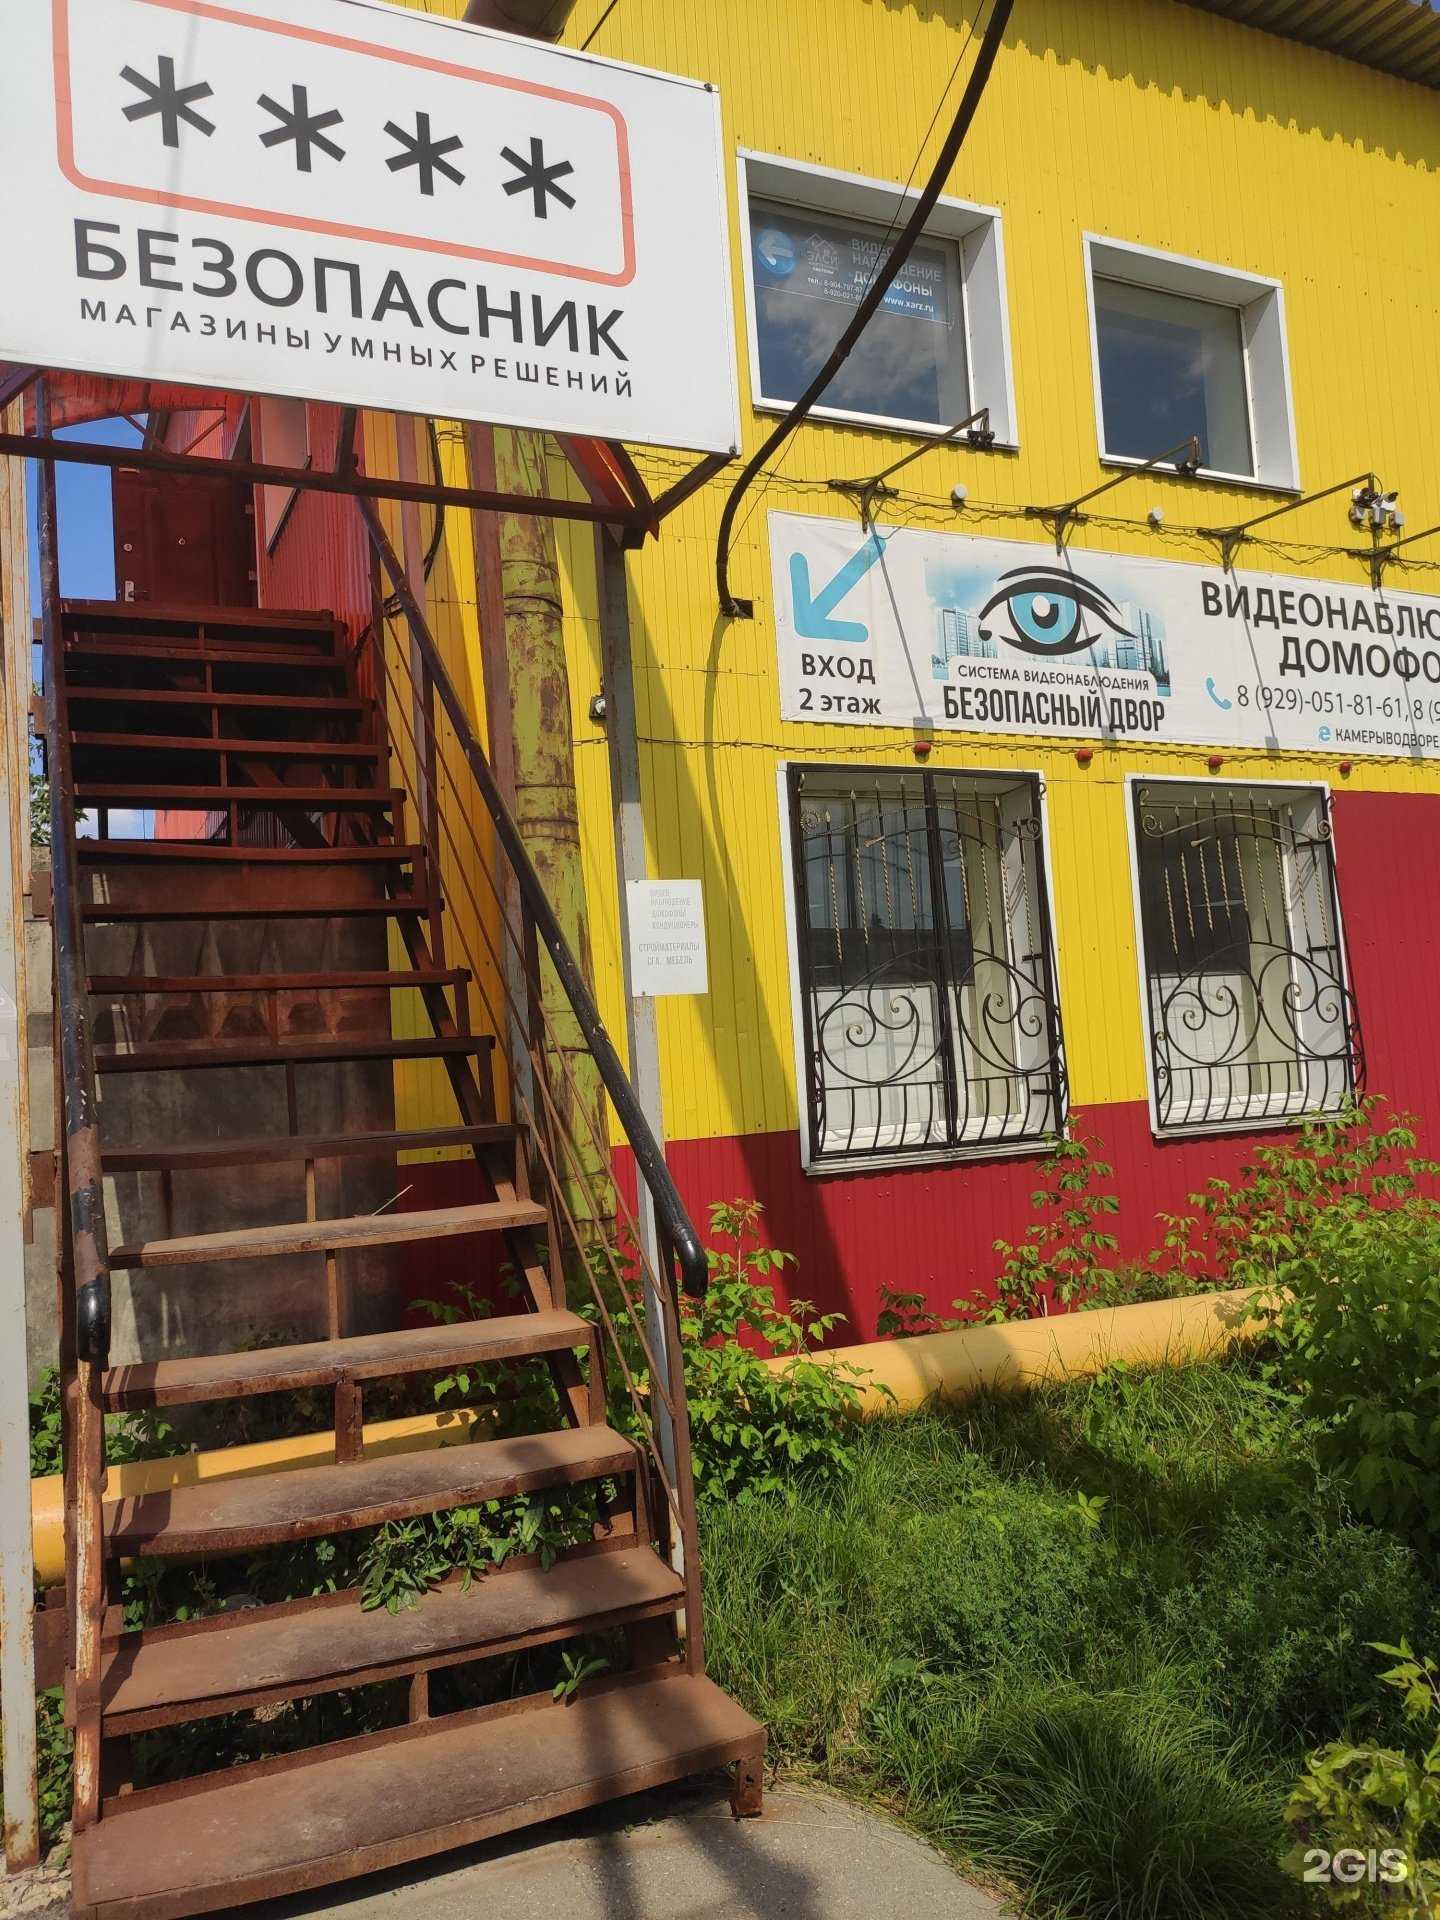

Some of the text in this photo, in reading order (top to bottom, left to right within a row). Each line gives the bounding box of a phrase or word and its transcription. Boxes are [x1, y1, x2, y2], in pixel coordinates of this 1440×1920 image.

[852, 253, 942, 282] НАБДЕНИЕ
[74, 218, 629, 361] БЕЗОПАСНИК
[854, 270, 933, 297] ДОФОНЫ
[884, 296, 934, 313] www.xarz.ru
[80, 298, 632, 398] МАГАЗИНЫ УМНЫХ РЕШЕНИЙ
[1201, 580, 1440, 641] ВИДЕОНАБЛЮ
[801, 653, 876, 685] ВХОД
[1279, 635, 1440, 683] ДОМОФО
[958, 665, 1149, 691] СИСТЕМА ВИДЕОНАБЛЮДЕНИЯ
[799, 687, 881, 715] 2 этаж
[943, 685, 1165, 734] БЕЗОПАСНЫЙ ДВОР
[1237, 685, 1249, 707] 8
